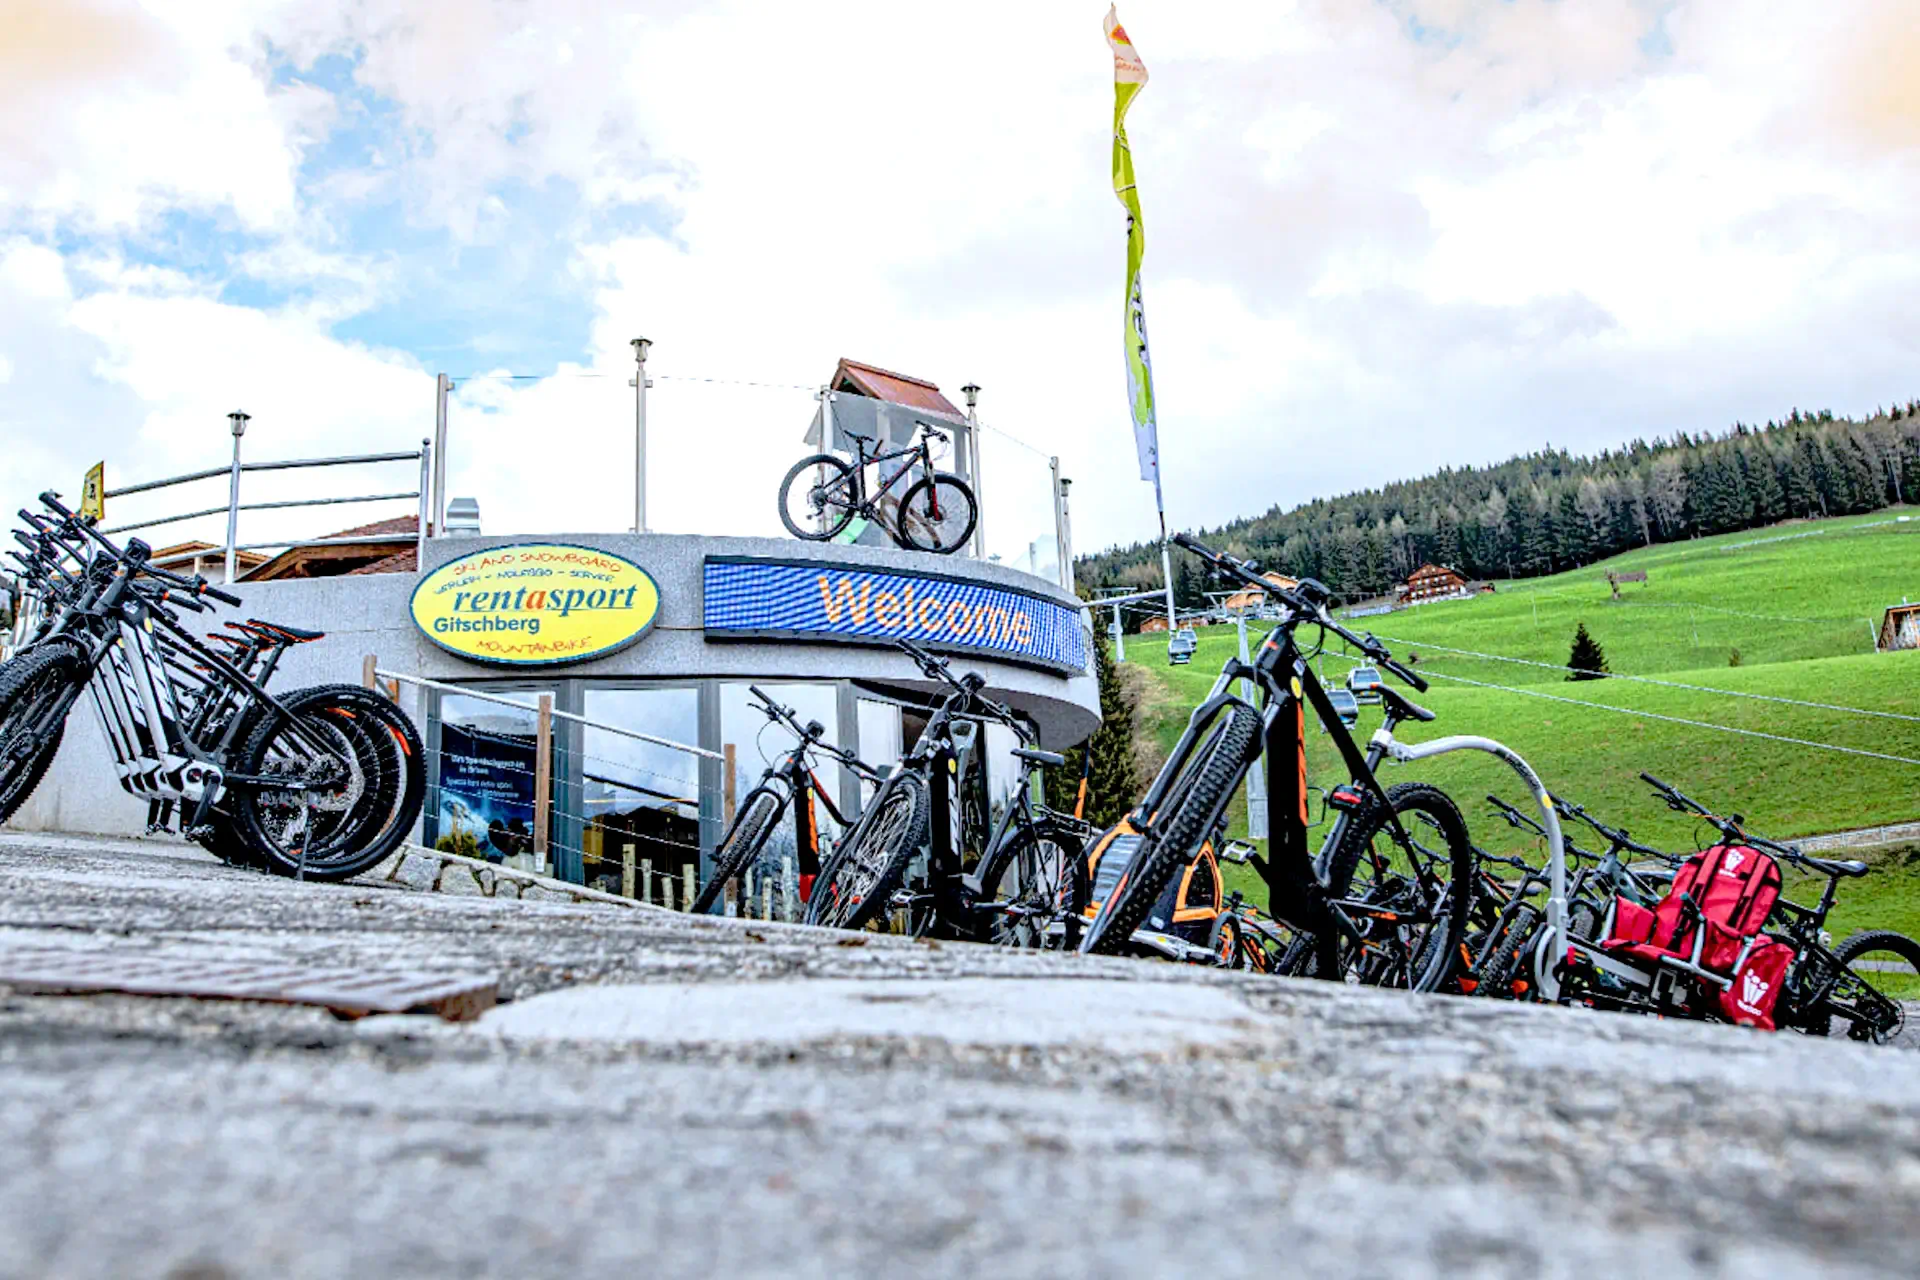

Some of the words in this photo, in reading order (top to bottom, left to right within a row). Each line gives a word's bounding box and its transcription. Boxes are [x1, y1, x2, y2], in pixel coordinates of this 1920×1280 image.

[453, 563, 476, 576] SKI
[480, 554, 515, 569] AND
[520, 552, 622, 573] SNOWBOARD
[453, 583, 638, 617] rentasport
[817, 576, 1032, 646] Welcome
[433, 616, 540, 635] Gitschberg
[476, 636, 592, 655] MOUNTAINBIKE
